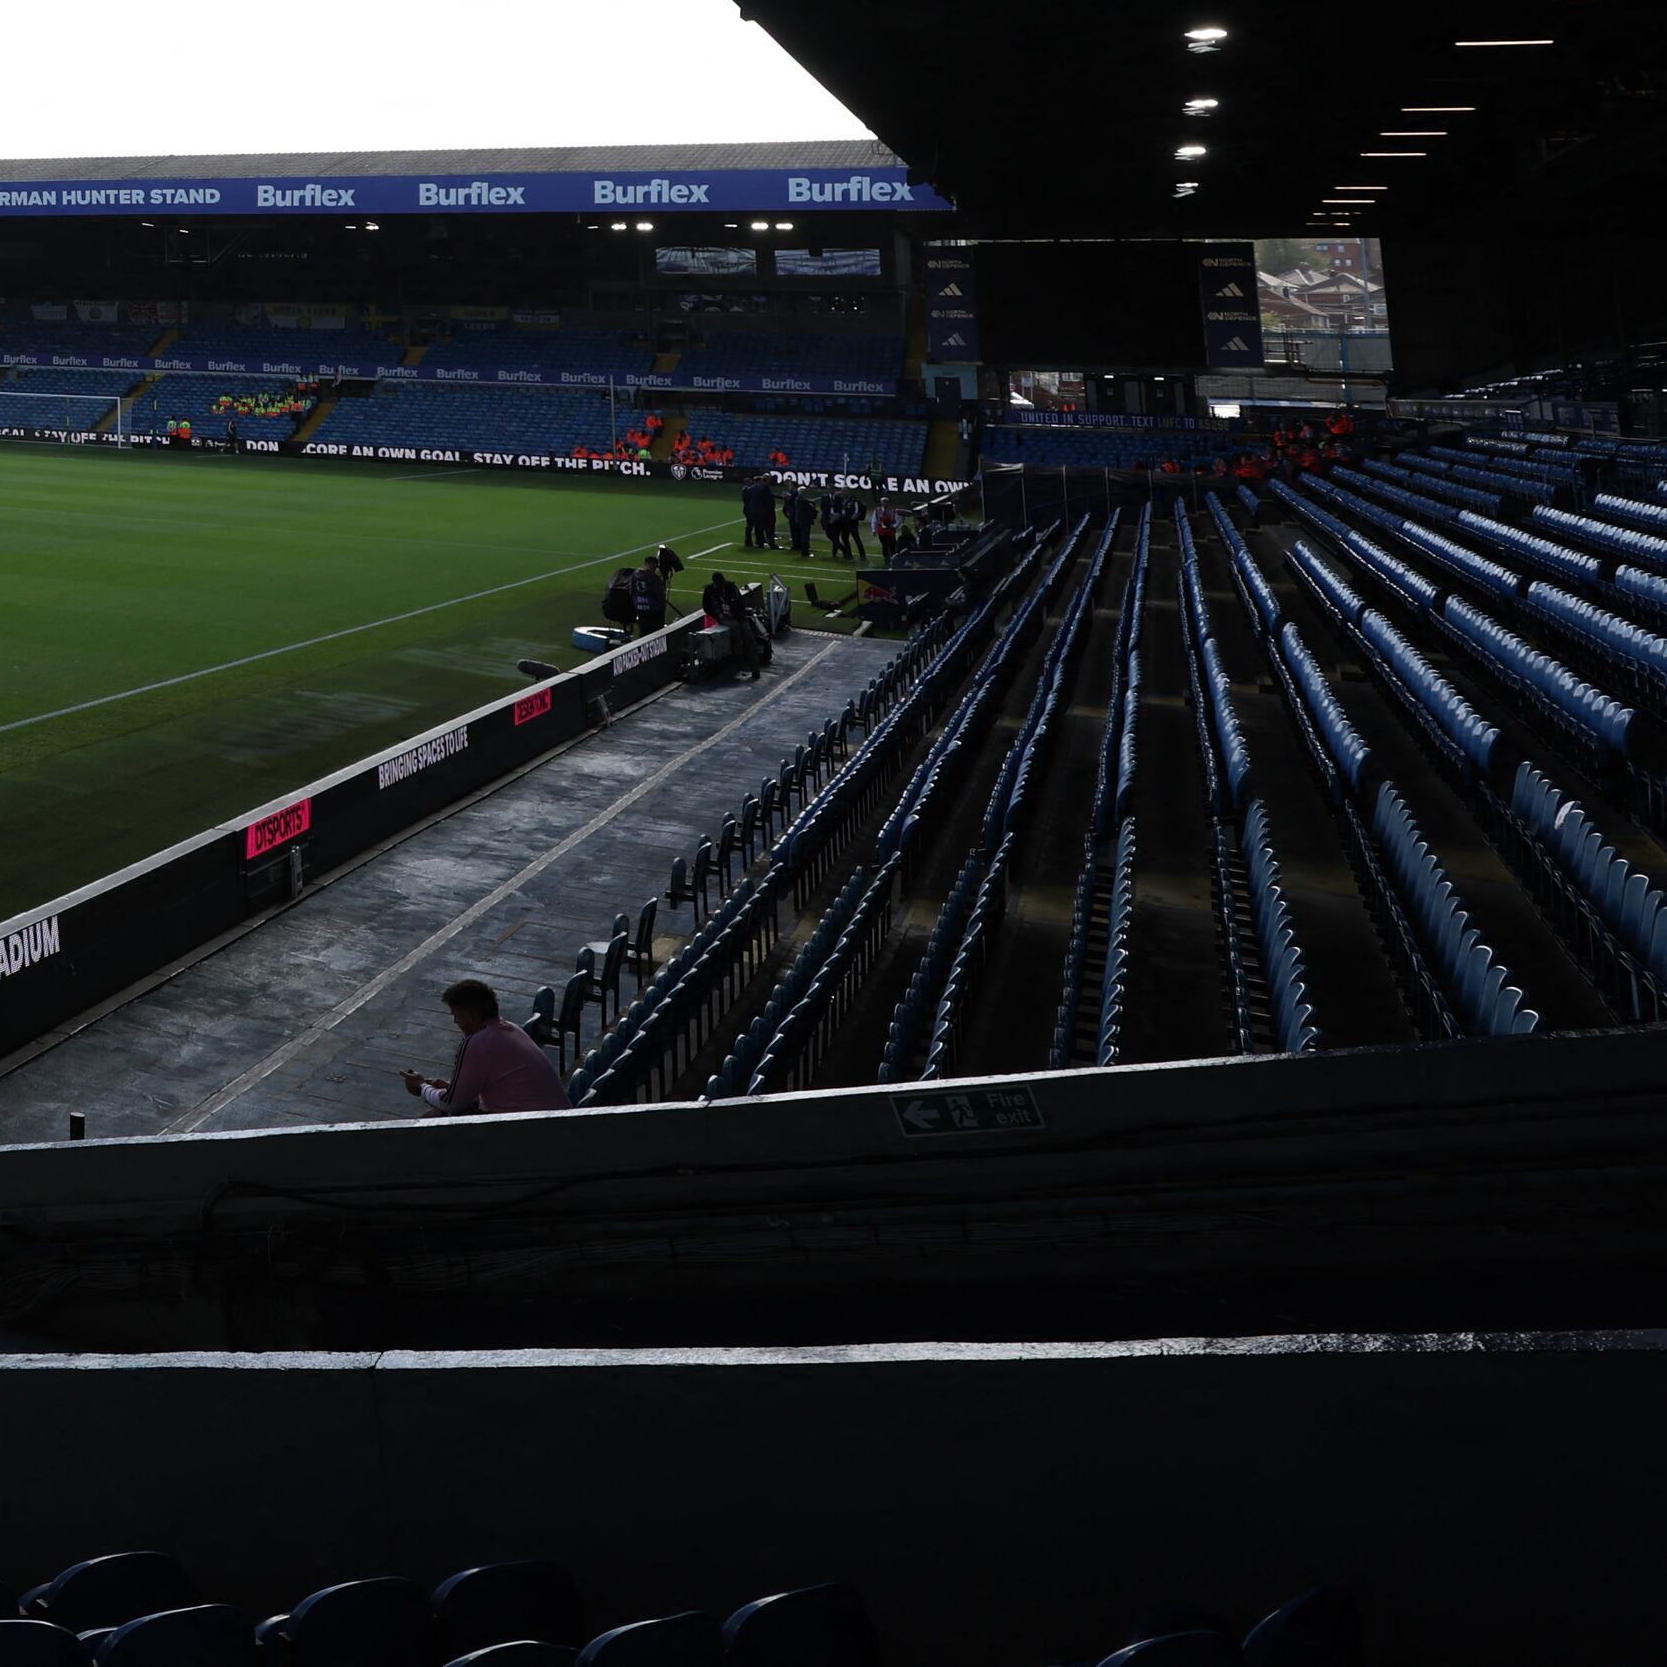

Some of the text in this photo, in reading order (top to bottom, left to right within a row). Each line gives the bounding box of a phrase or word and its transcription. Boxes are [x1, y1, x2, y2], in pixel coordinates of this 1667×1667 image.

[63, 190, 144, 205] HUNTER
[151, 189, 220, 204] STAND
[258, 184, 355, 206] Burflex
[420, 176, 913, 205] Burflex Burflex Burflex
[2, 355, 39, 367] Burflex
[102, 358, 140, 371] Burflex
[207, 361, 247, 374] Burflex
[376, 367, 419, 380] Burflex
[436, 369, 480, 382] Burflex
[497, 371, 541, 384] Burflex
[560, 373, 608, 386] Burflex
[625, 375, 671, 388] Burflex
[692, 377, 739, 390] Burflex
[763, 379, 810, 392] Burflex
[834, 381, 883, 391] Burflex
[1020, 412, 1058, 423] UNITED
[1062, 413, 1074, 423] IN
[1130, 416, 1154, 427] TEXT
[353, 446, 416, 458] AN OWN
[903, 479, 929, 493] AN
[378, 725, 468, 790] BRINGING SPACES TO LIFE
[255, 804, 302, 848] DTSPORTS
[986, 1093, 1026, 1108] Fire
[995, 1108, 1032, 1125] exit
